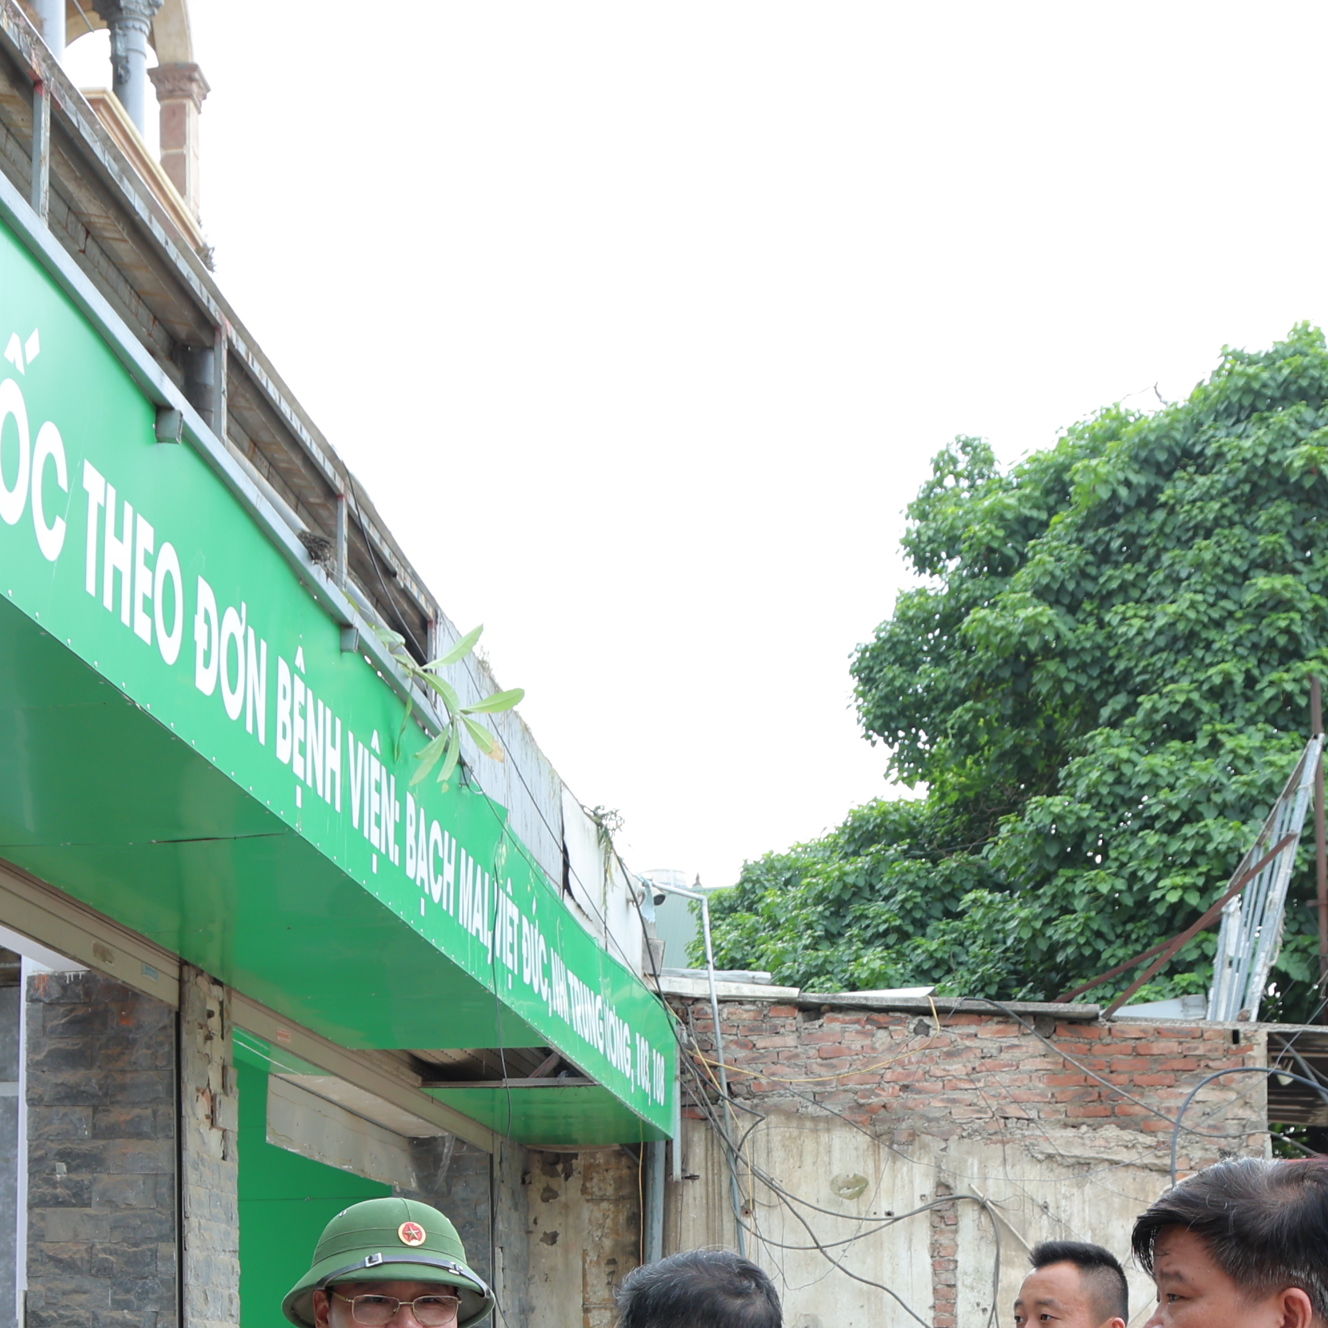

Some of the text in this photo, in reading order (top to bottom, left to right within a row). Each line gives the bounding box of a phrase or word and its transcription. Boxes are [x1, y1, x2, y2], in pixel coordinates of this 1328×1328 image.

[83, 458, 184, 666] THEO
[193, 574, 267, 746] ĐƠN
[275, 645, 341, 813] BỆNH
[348, 729, 400, 874] VIỆN:
[405, 791, 457, 917] BẠCH
[458, 847, 493, 964] MAI,
[493, 877, 520, 990] VIỆT
[521, 896, 552, 1017] ĐỨC,
[550, 947, 570, 1025] NHI
[566, 969, 604, 1052] TRUNG
[652, 1048, 666, 1107] 108
